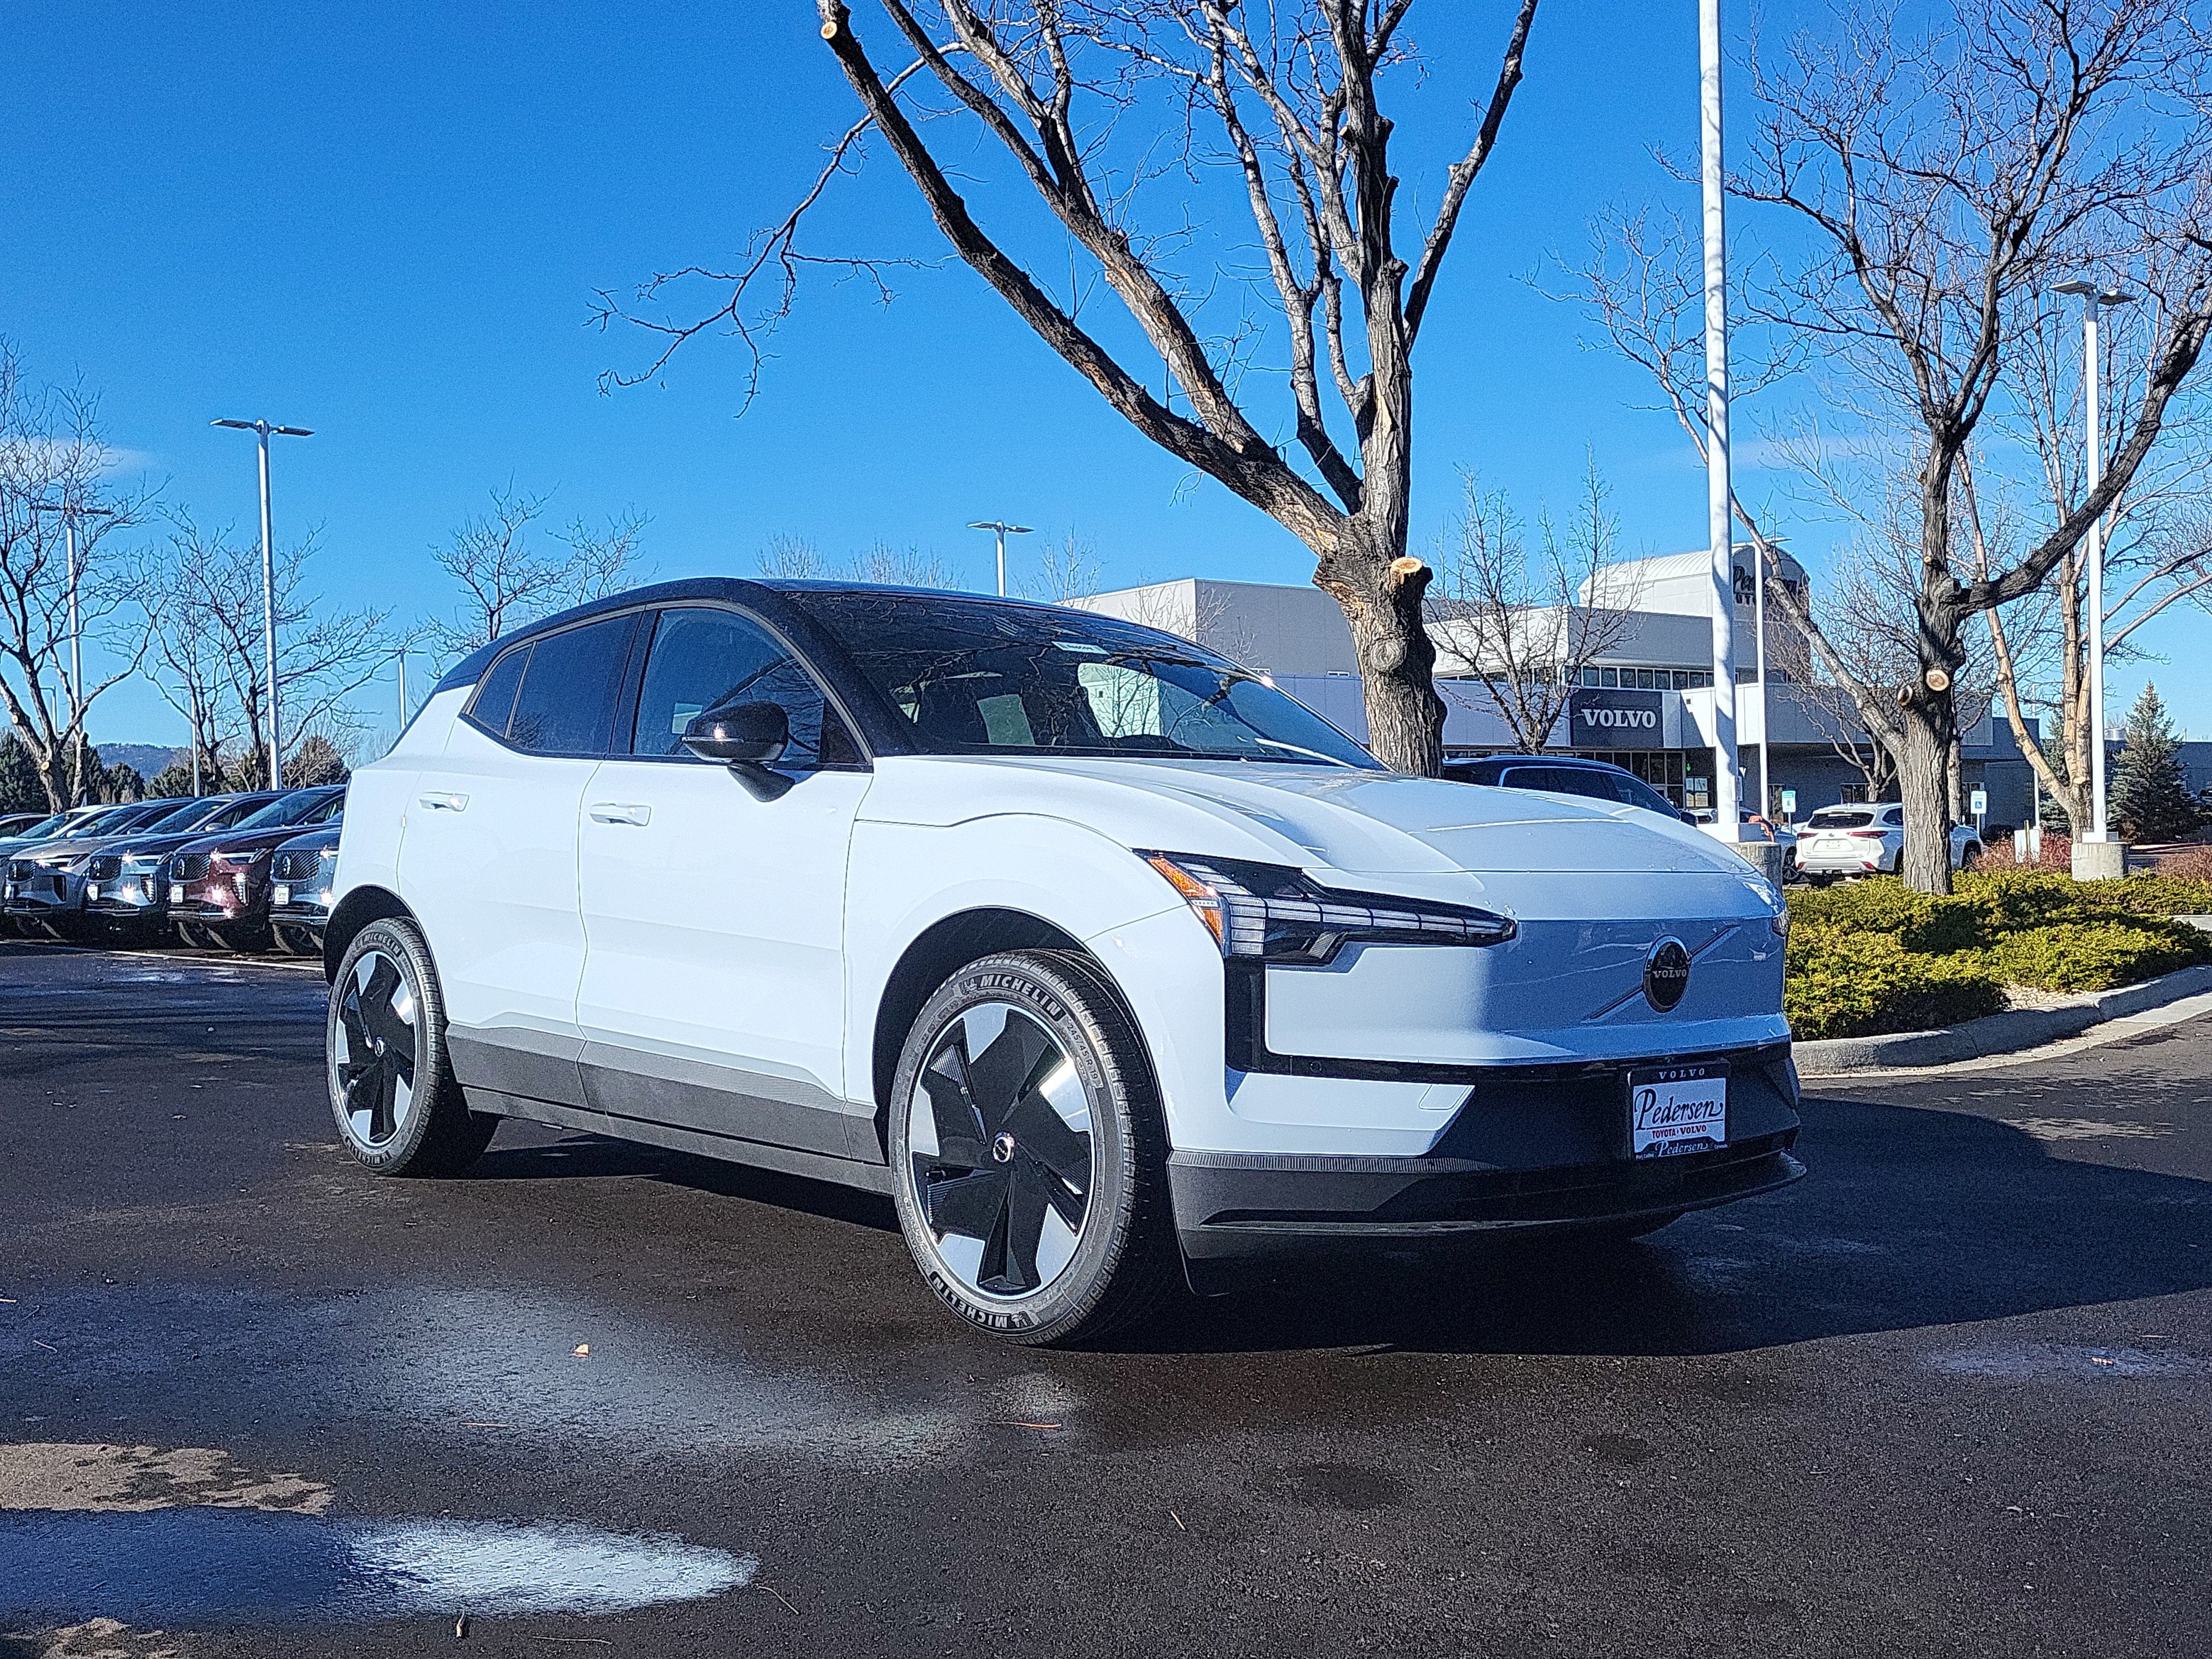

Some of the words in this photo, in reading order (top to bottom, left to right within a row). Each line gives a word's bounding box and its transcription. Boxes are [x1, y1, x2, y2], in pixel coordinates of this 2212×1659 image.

[1581, 708, 1656, 728] VOLVO
[364, 933, 400, 954] MICHELIN
[1652, 969, 1687, 979] VOLVO
[979, 974, 1061, 1016] MICHELIN
[1066, 1024, 1090, 1057] 245/45
[1085, 1058, 1094, 1067] R
[1089, 1069, 1099, 1080] 19
[1659, 1068, 1705, 1079] VOLVO
[1634, 1089, 1723, 1131] Pedersen
[1652, 1128, 1676, 1139] TOYOTA
[1681, 1125, 1707, 1135] VOLVO
[1655, 1140, 1708, 1157] Pedersen
[933, 1276, 1008, 1328] MICHELIN
